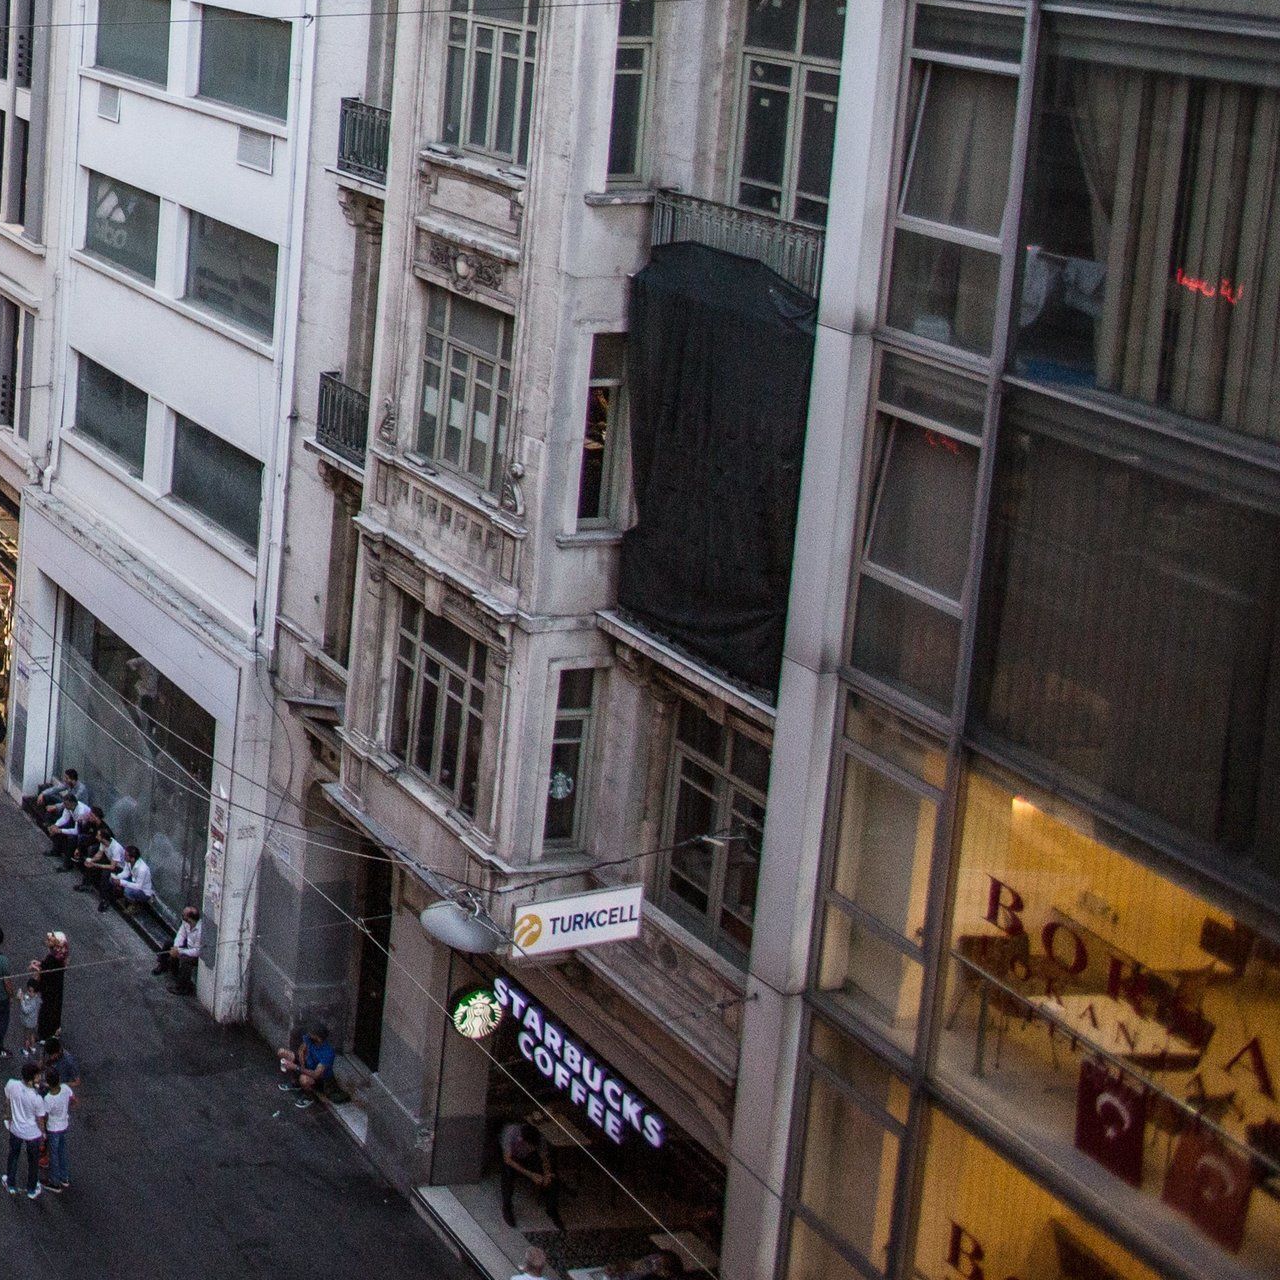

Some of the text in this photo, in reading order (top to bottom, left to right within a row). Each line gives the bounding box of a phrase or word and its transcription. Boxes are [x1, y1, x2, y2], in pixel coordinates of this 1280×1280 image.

[549, 904, 639, 936] TURKCELL
[492, 976, 667, 1149] STARBUCKS
[517, 1030, 627, 1145] COFFEE
